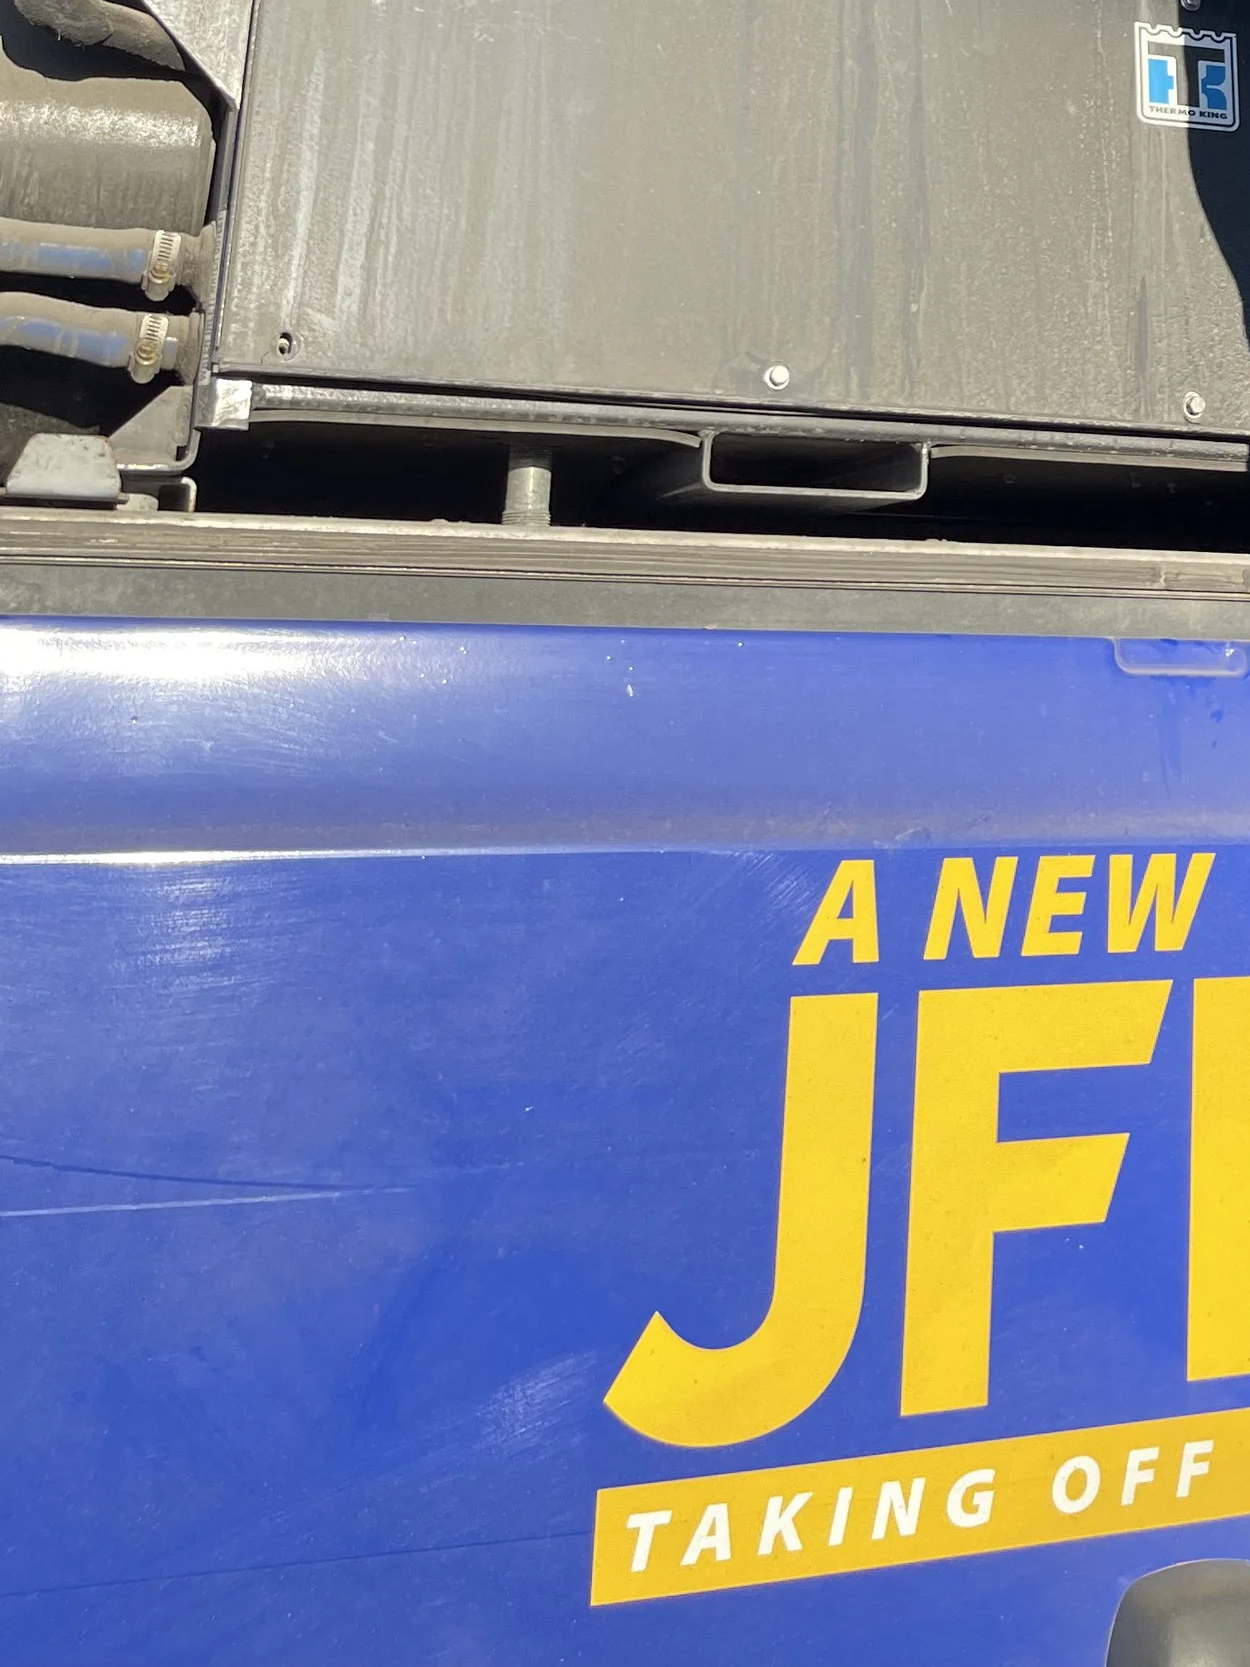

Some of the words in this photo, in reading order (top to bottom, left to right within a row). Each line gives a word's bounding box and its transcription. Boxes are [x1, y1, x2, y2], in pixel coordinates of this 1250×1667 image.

[1148, 105, 1197, 117] THERMO
[1199, 110, 1228, 120] KING
[793, 859, 880, 966] A
[923, 852, 1216, 961] NEW
[625, 1469, 997, 1573] TAKING
[1051, 1438, 1215, 1516] OFF
